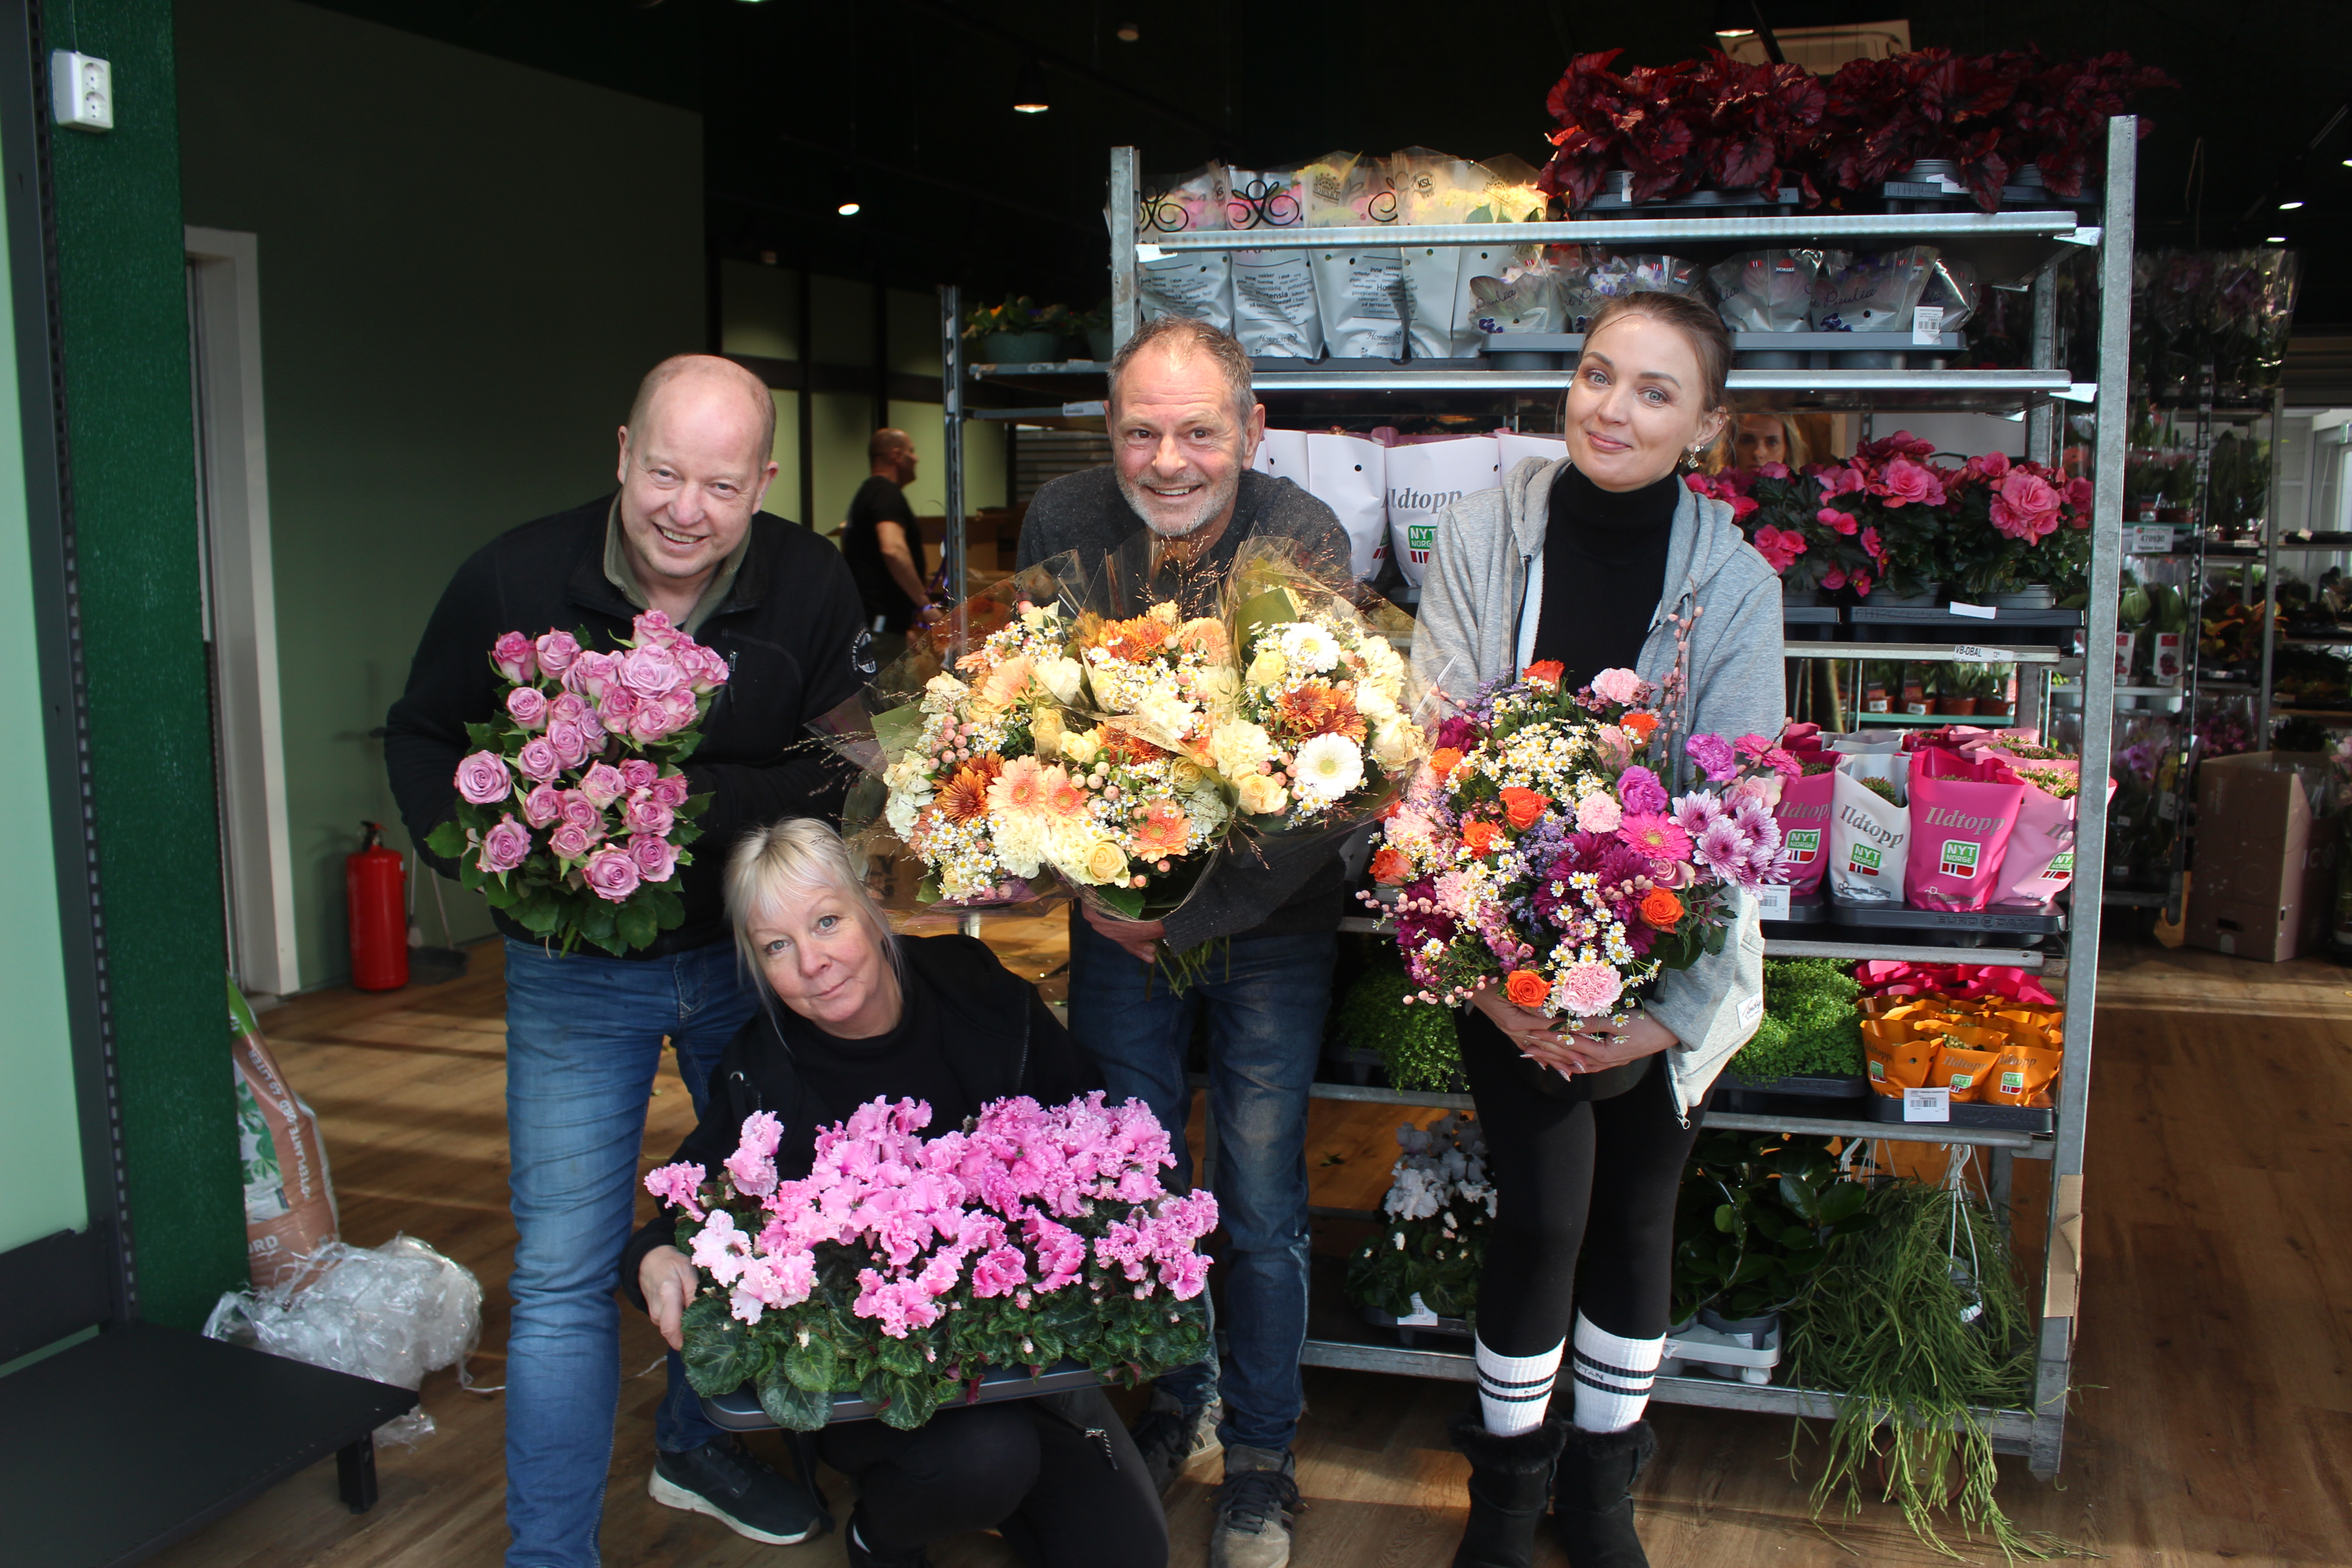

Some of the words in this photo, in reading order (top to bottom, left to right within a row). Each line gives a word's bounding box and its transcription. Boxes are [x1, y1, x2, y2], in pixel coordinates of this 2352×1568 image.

[1417, 177, 1432, 189] KSL
[1823, 287, 1877, 308] Paulia
[1840, 804, 1904, 848] Ildtopp
[1924, 806, 2005, 836] Ildtopp
[1791, 833, 1818, 842] NYT
[1854, 845, 1881, 861] NYT
[1947, 844, 1976, 857] NYT
[1853, 854, 1877, 867] NORGE
[1946, 854, 1972, 863] NORGE
[2054, 855, 2073, 863] NY
[1942, 1056, 1988, 1072] Ildtopp
[1998, 1054, 2037, 1068] ldtopp
